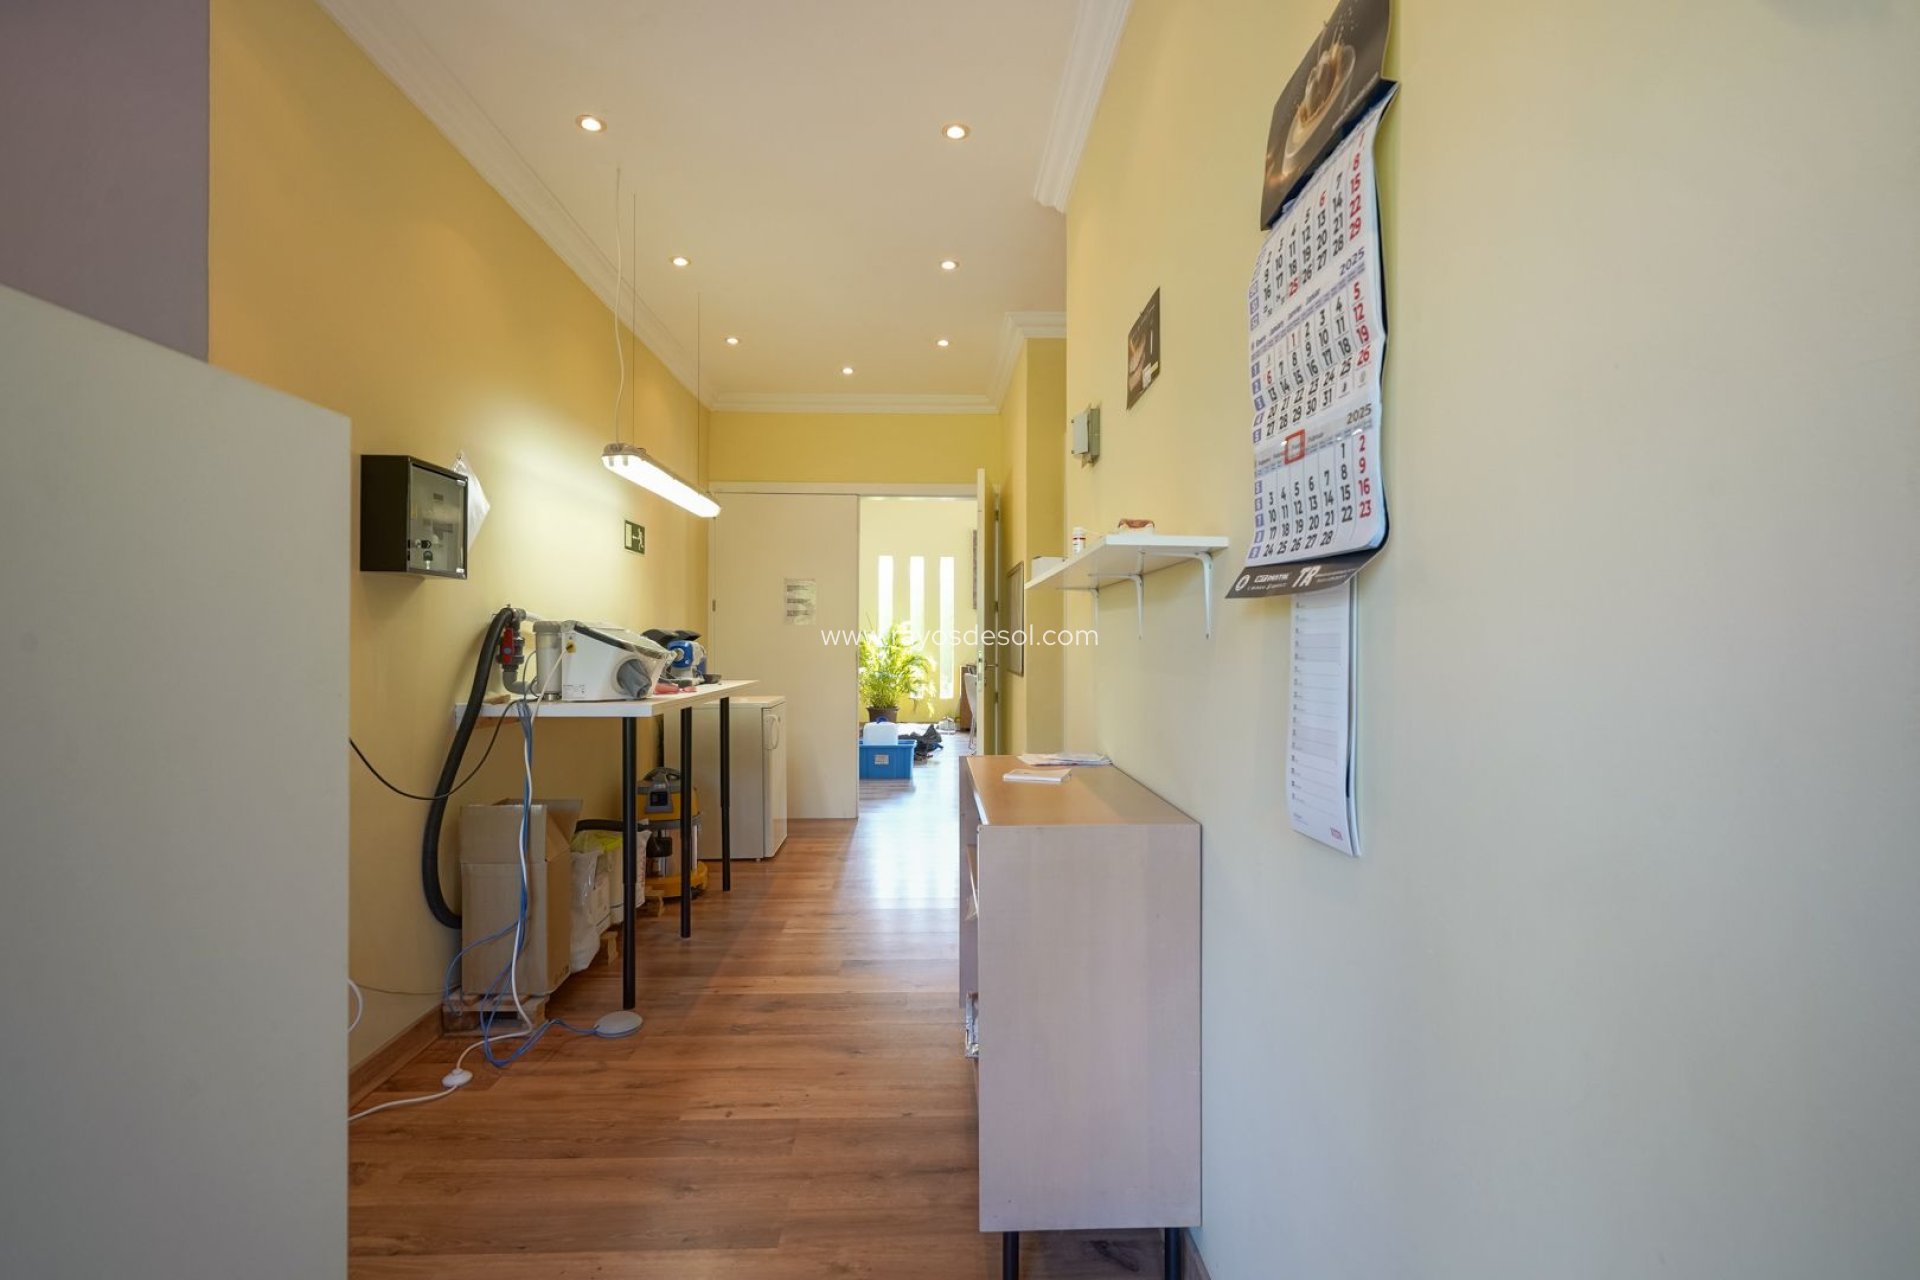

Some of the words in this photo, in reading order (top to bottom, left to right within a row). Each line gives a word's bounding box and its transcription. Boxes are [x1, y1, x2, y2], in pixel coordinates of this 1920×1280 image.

[1275, 254, 1282, 271] 10
[1289, 240, 1295, 257] 11
[1302, 225, 1311, 245] 12
[1317, 209, 1326, 229] 13
[1332, 192, 1343, 213] 14
[1350, 173, 1361, 194] 15
[1276, 272, 1283, 289] 17
[1302, 245, 1311, 264] 19
[1317, 229, 1327, 251] 20
[1333, 212, 1343, 235] 21
[1350, 194, 1361, 218] 22
[1302, 264, 1312, 285] 26
[1317, 249, 1327, 271] 27
[1333, 234, 1344, 256] 28
[1350, 217, 1361, 240] 29
[1340, 246, 1365, 276] 2025
[1292, 333, 1296, 347] 1
[1305, 321, 1310, 337] 2
[1319, 308, 1326, 326] 3
[1336, 296, 1343, 312] 4
[1353, 281, 1360, 300] 5
[1266, 369, 1273, 385] 6
[1279, 360, 1284, 376] 7
[1292, 352, 1297, 367] 8
[1306, 341, 1312, 357] 9
[1319, 328, 1329, 346] 10
[1336, 316, 1345, 334] 11
[1353, 302, 1365, 323] 12
[1268, 387, 1277, 401] 13
[1280, 378, 1290, 394] 14
[1293, 369, 1304, 385] 15
[1306, 358, 1318, 377] 16
[1322, 347, 1333, 366] 17
[1338, 337, 1351, 356] 18
[1356, 325, 1369, 344] 19
[1308, 377, 1319, 395] 23
[1323, 367, 1335, 386] 24
[1340, 357, 1352, 377] 25
[1356, 345, 1371, 367] 26
[1266, 420, 1275, 437] 27
[1279, 413, 1288, 430] 28
[1293, 405, 1302, 423] 29
[1306, 396, 1317, 416] 30
[1323, 387, 1332, 407] 31
[1346, 403, 1372, 425] 2025
[1341, 442, 1346, 459] 1
[1359, 434, 1366, 452] 2
[1268, 491, 1274, 506] 3
[1281, 487, 1287, 500] 4
[1294, 481, 1300, 497] 5
[1308, 476, 1315, 492] 6
[1324, 470, 1330, 487] 7
[1341, 463, 1348, 481] 8
[1359, 457, 1366, 474] 9
[1268, 508, 1277, 523] 10
[1281, 504, 1289, 519] 11
[1293, 500, 1303, 515] 12
[1308, 494, 1318, 511] 13
[1324, 490, 1334, 507] 14
[1340, 484, 1351, 502] 15
[1358, 478, 1371, 497] 16
[1263, 543, 1274, 558] 24
[1276, 540, 1288, 555] 25
[1290, 537, 1302, 552] 26
[1304, 533, 1317, 550] 27
[1320, 530, 1334, 547] 28
[1269, 525, 1277, 540] 17
[1282, 522, 1290, 537] 18
[1295, 518, 1304, 534] 19
[1308, 514, 1319, 531] 20
[1325, 510, 1334, 527] 21
[1341, 505, 1353, 523] 22
[1359, 500, 1372, 519] 23
